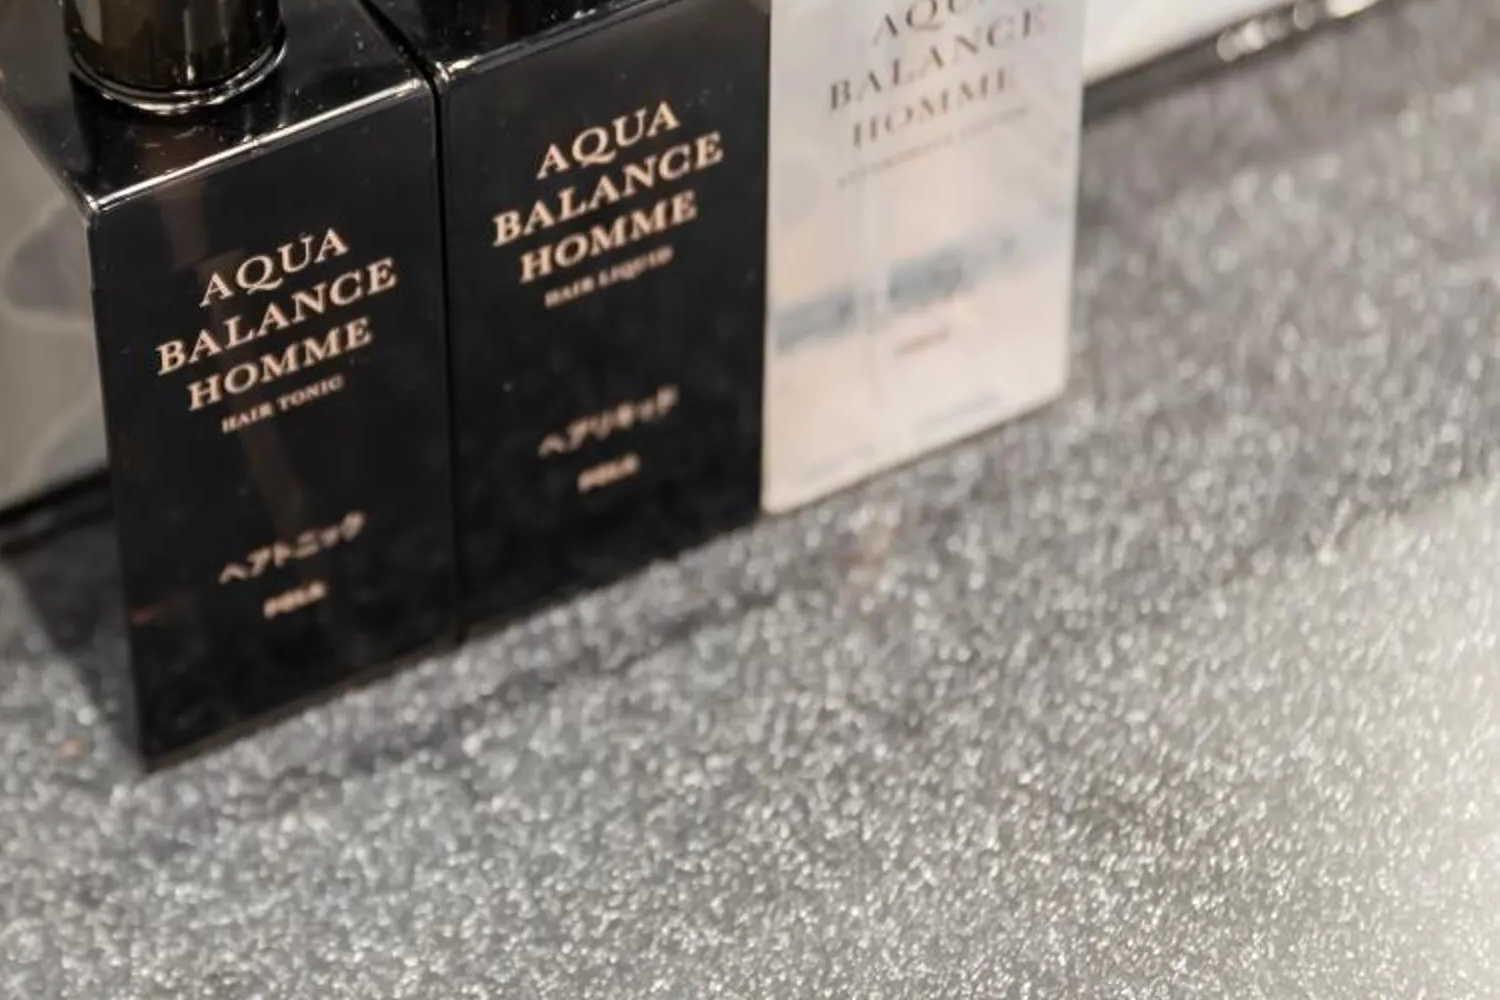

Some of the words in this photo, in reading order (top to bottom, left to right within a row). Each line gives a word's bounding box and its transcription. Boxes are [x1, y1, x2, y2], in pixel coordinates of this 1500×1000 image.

[536, 100, 681, 180] AQUA
[492, 130, 724, 247] BALANCE
[199, 227, 349, 308] AQUA
[520, 189, 698, 283] HOMME
[155, 257, 397, 376] BALANCE
[187, 316, 373, 411] HOMME
[221, 402, 273, 433] HAIR
[276, 375, 344, 411] TONIC
